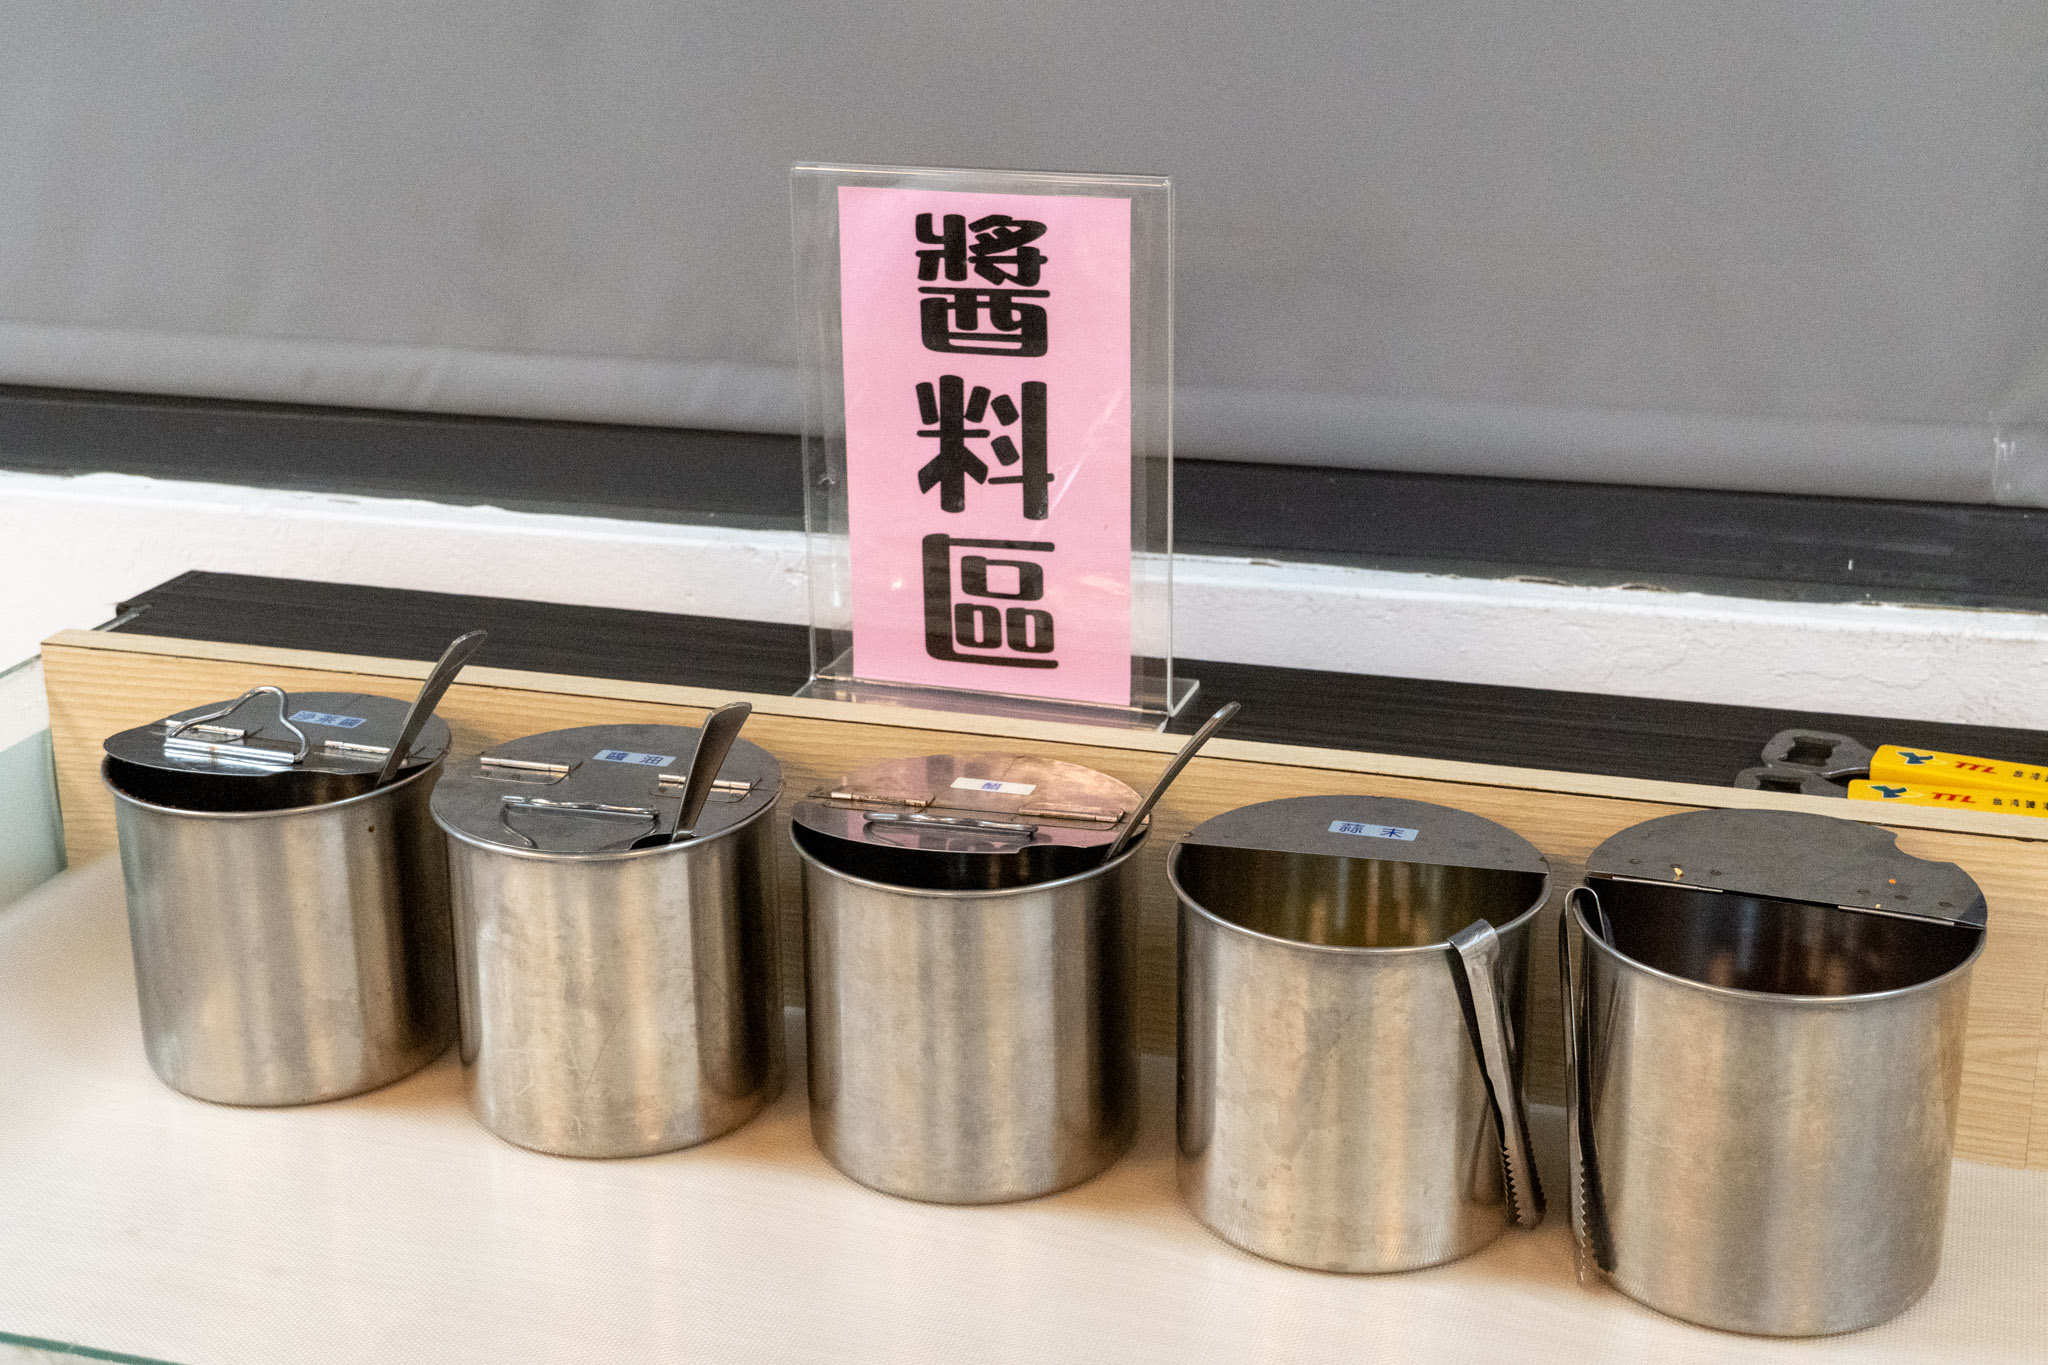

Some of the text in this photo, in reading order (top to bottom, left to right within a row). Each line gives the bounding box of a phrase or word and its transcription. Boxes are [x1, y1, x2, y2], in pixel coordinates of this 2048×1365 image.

[914, 212, 1059, 669] 醬料區
[605, 751, 663, 765] 醬油
[1955, 761, 1997, 774] TTL
[1932, 792, 1976, 804] TTL
[1339, 822, 1404, 837] 蒜末
